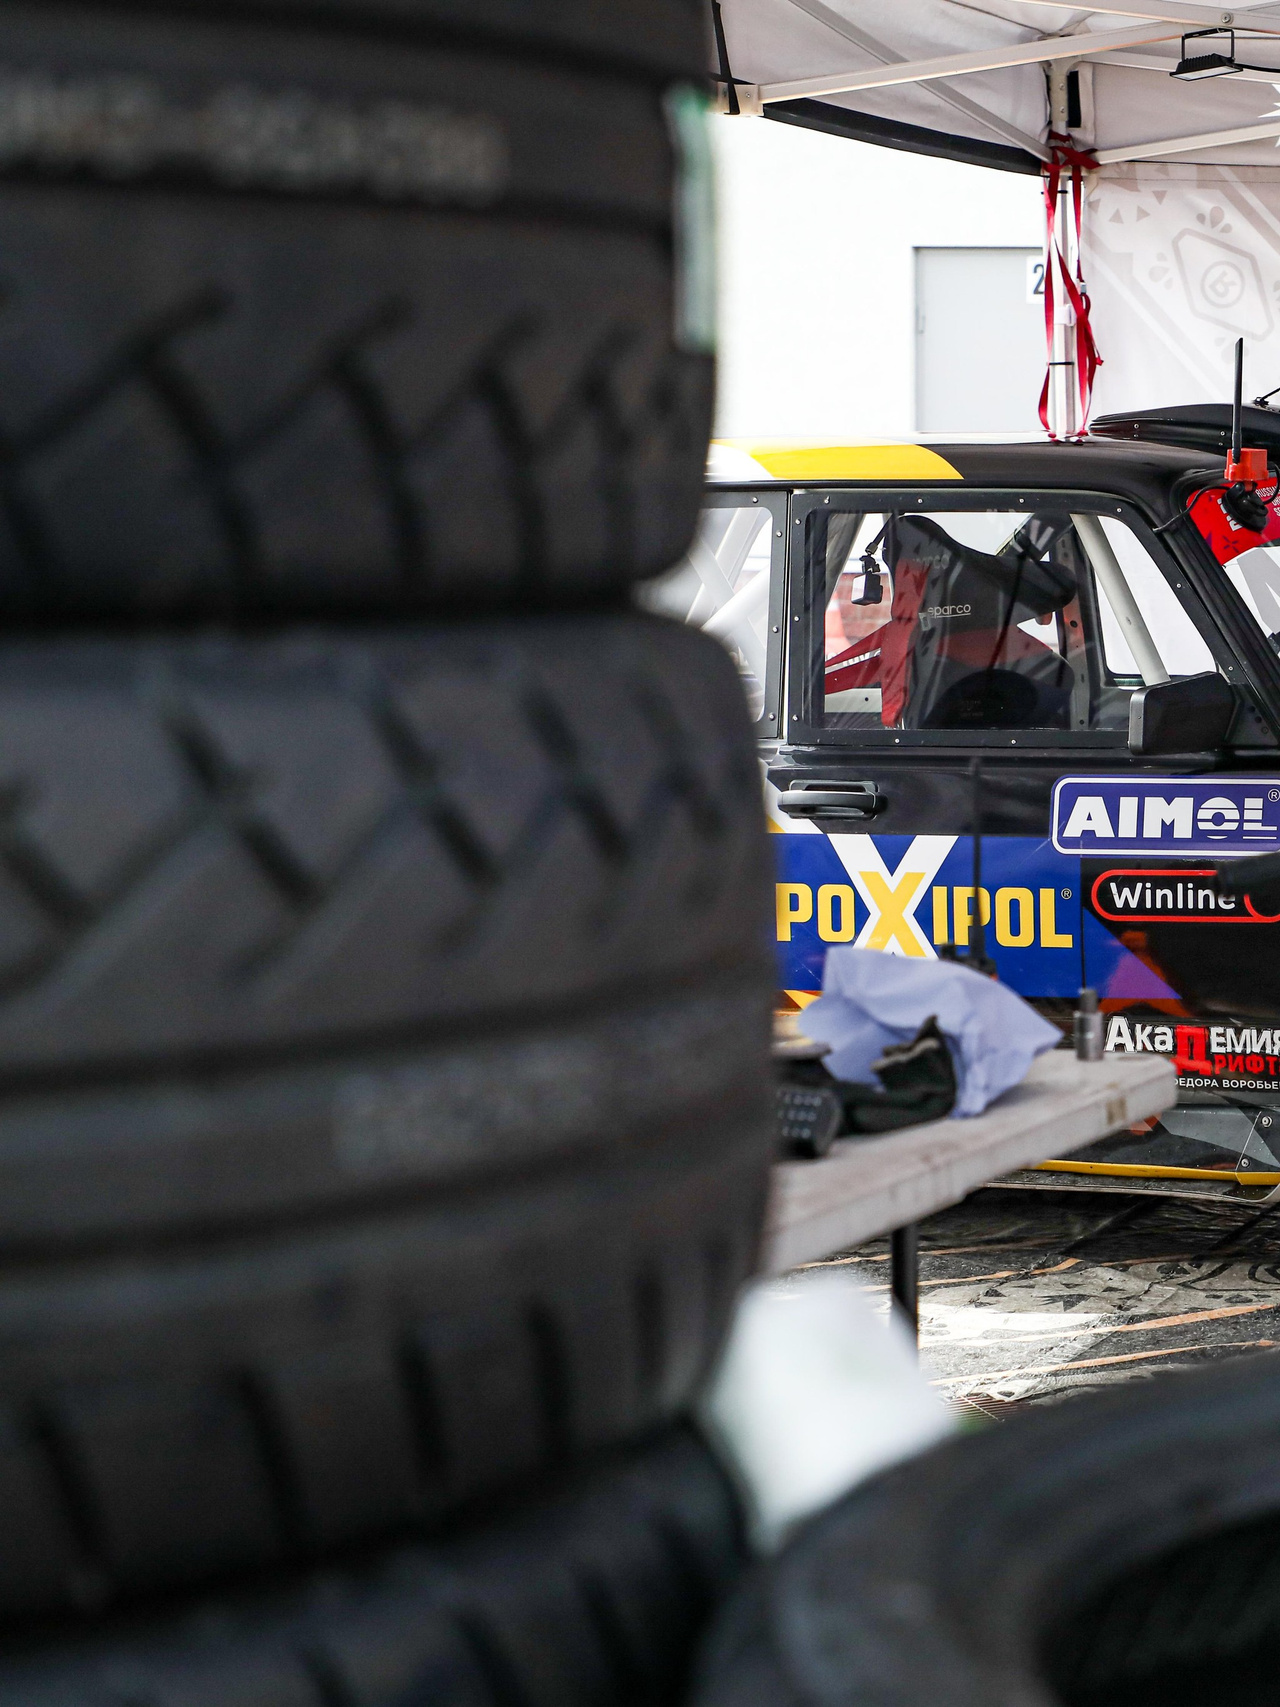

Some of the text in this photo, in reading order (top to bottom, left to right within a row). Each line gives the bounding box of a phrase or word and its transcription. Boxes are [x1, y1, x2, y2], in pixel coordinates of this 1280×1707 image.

[927, 603, 972, 617] sparco
[1062, 796, 1278, 840] AIMOL
[776, 834, 1074, 959] POXIPOL
[1109, 882, 1236, 910] Winline
